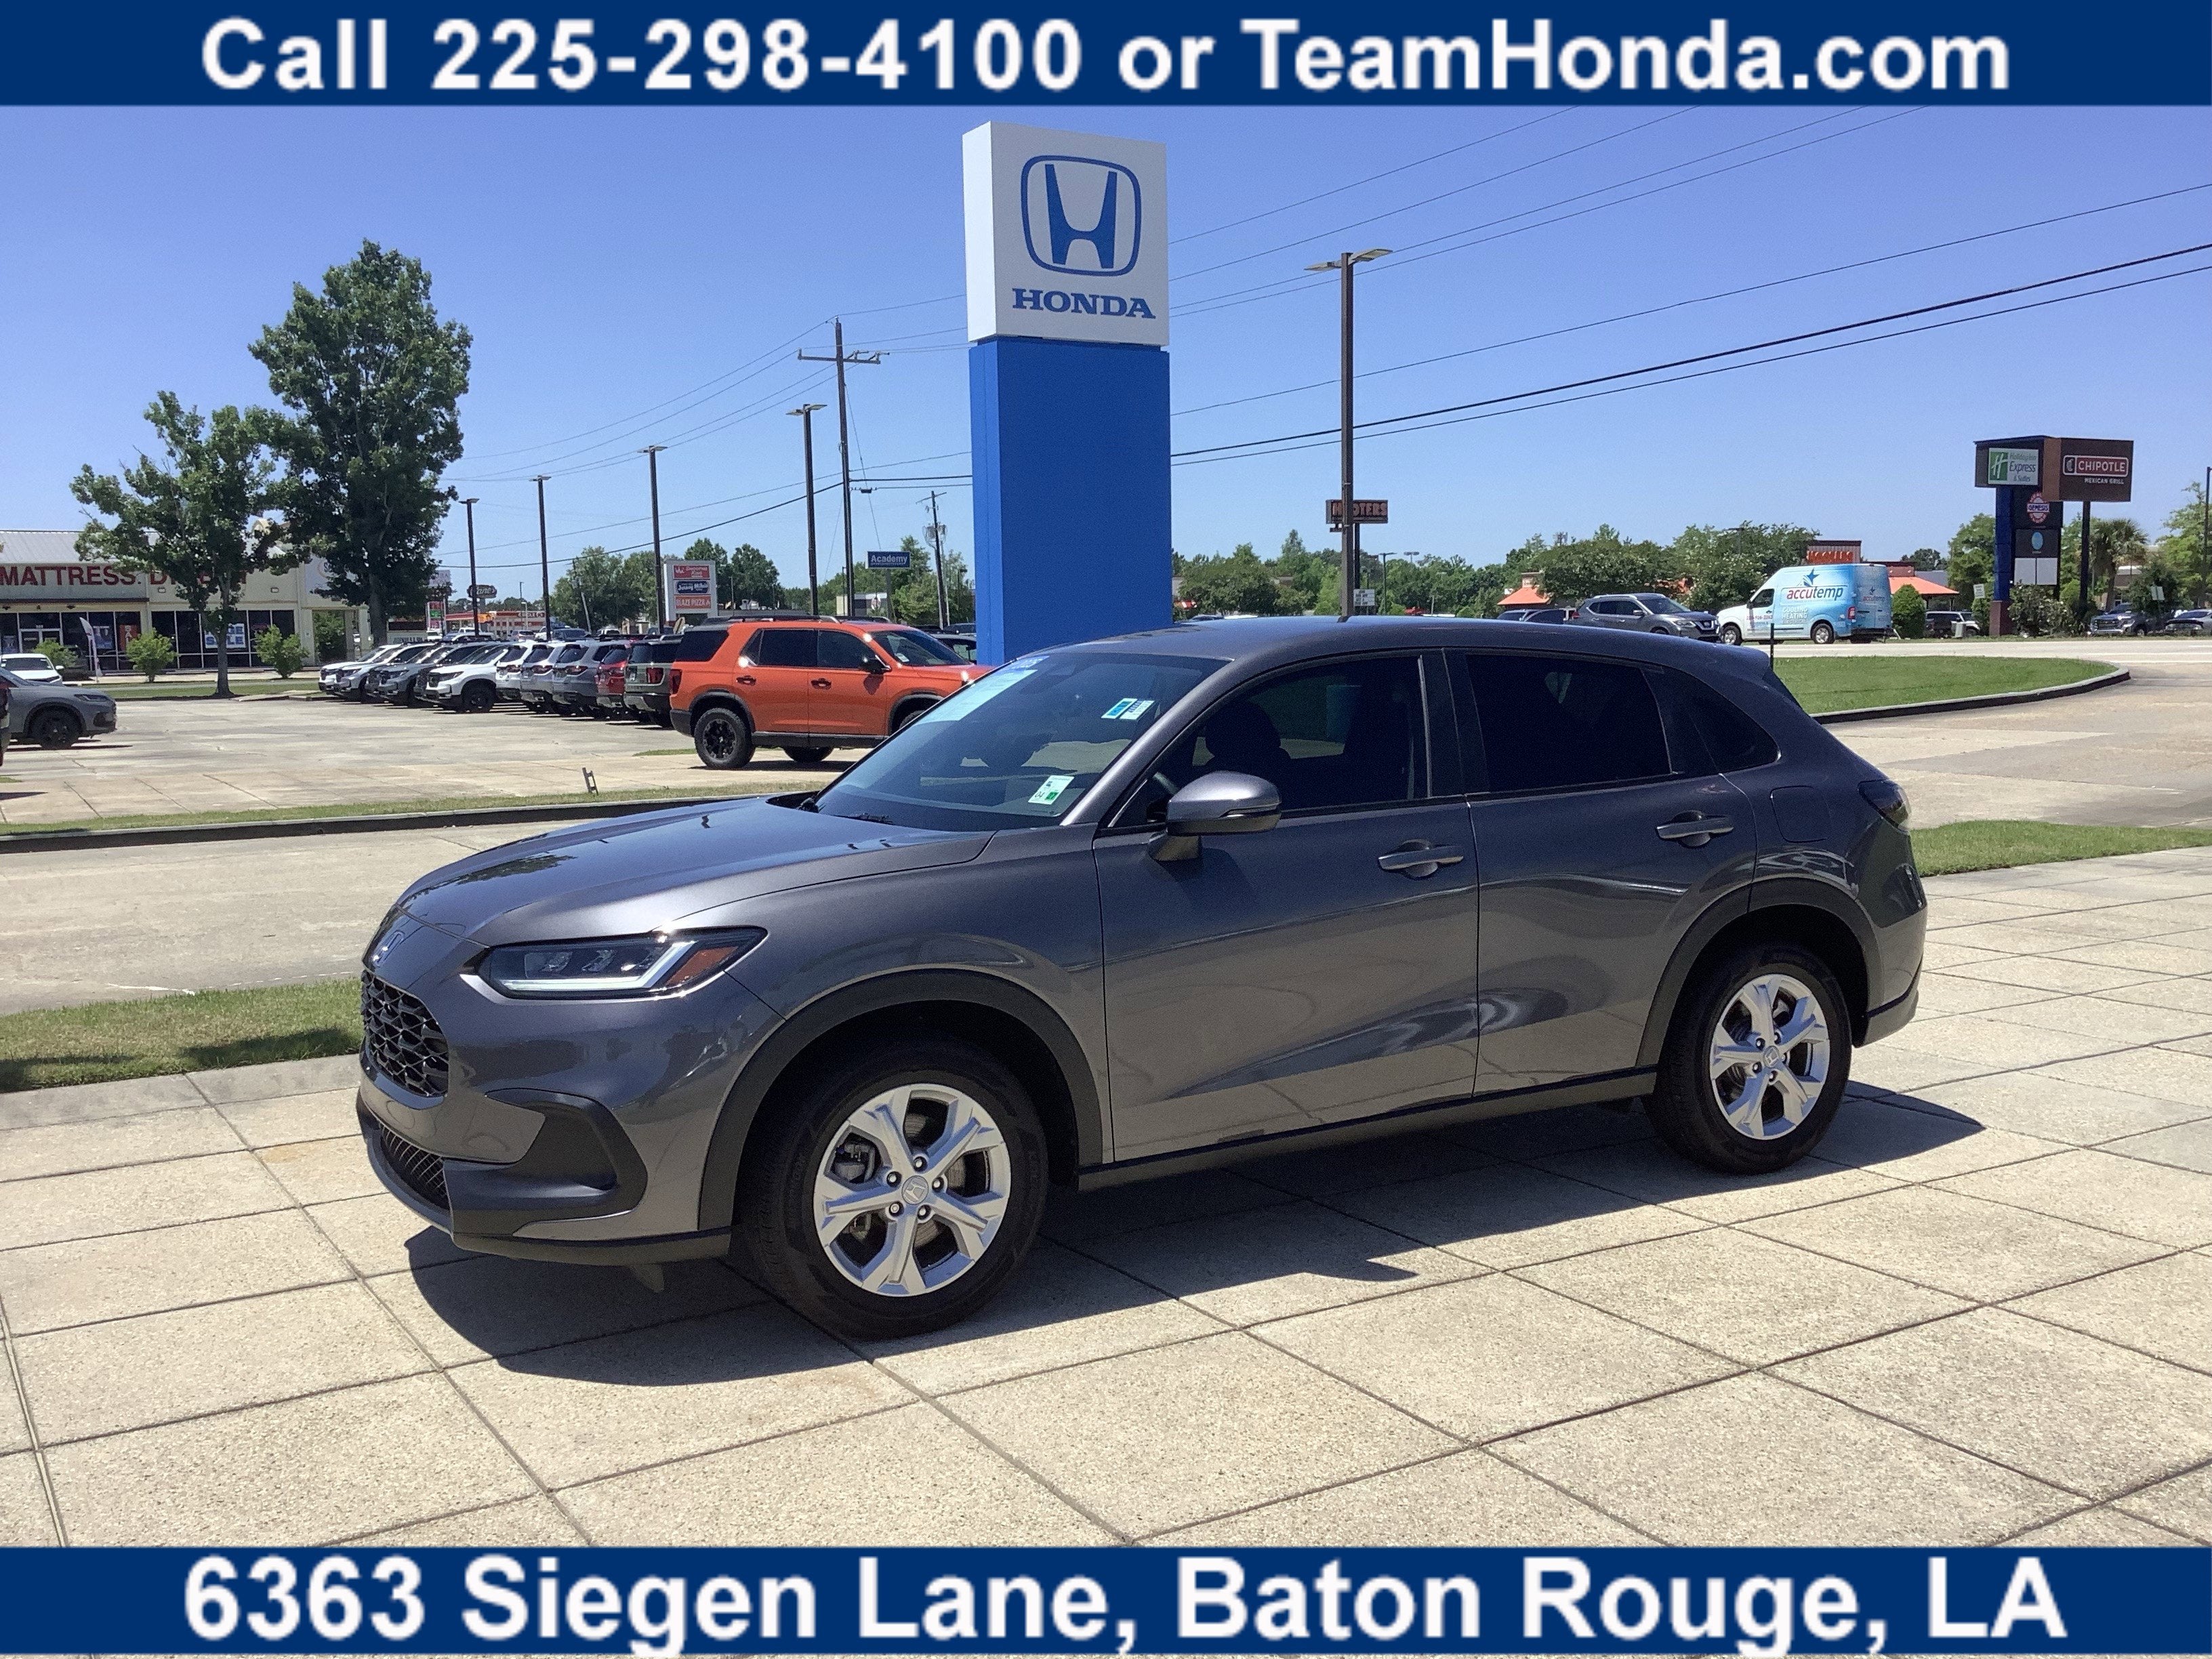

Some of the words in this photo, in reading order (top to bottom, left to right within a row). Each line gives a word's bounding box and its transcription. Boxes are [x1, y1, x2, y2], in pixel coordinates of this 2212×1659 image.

[1012, 288, 1156, 319] HONDA
[2009, 461, 2036, 474] Express
[2078, 460, 2126, 472] CHIPOTLE
[871, 554, 907, 565] Academy
[1786, 586, 1844, 600] accutemp
